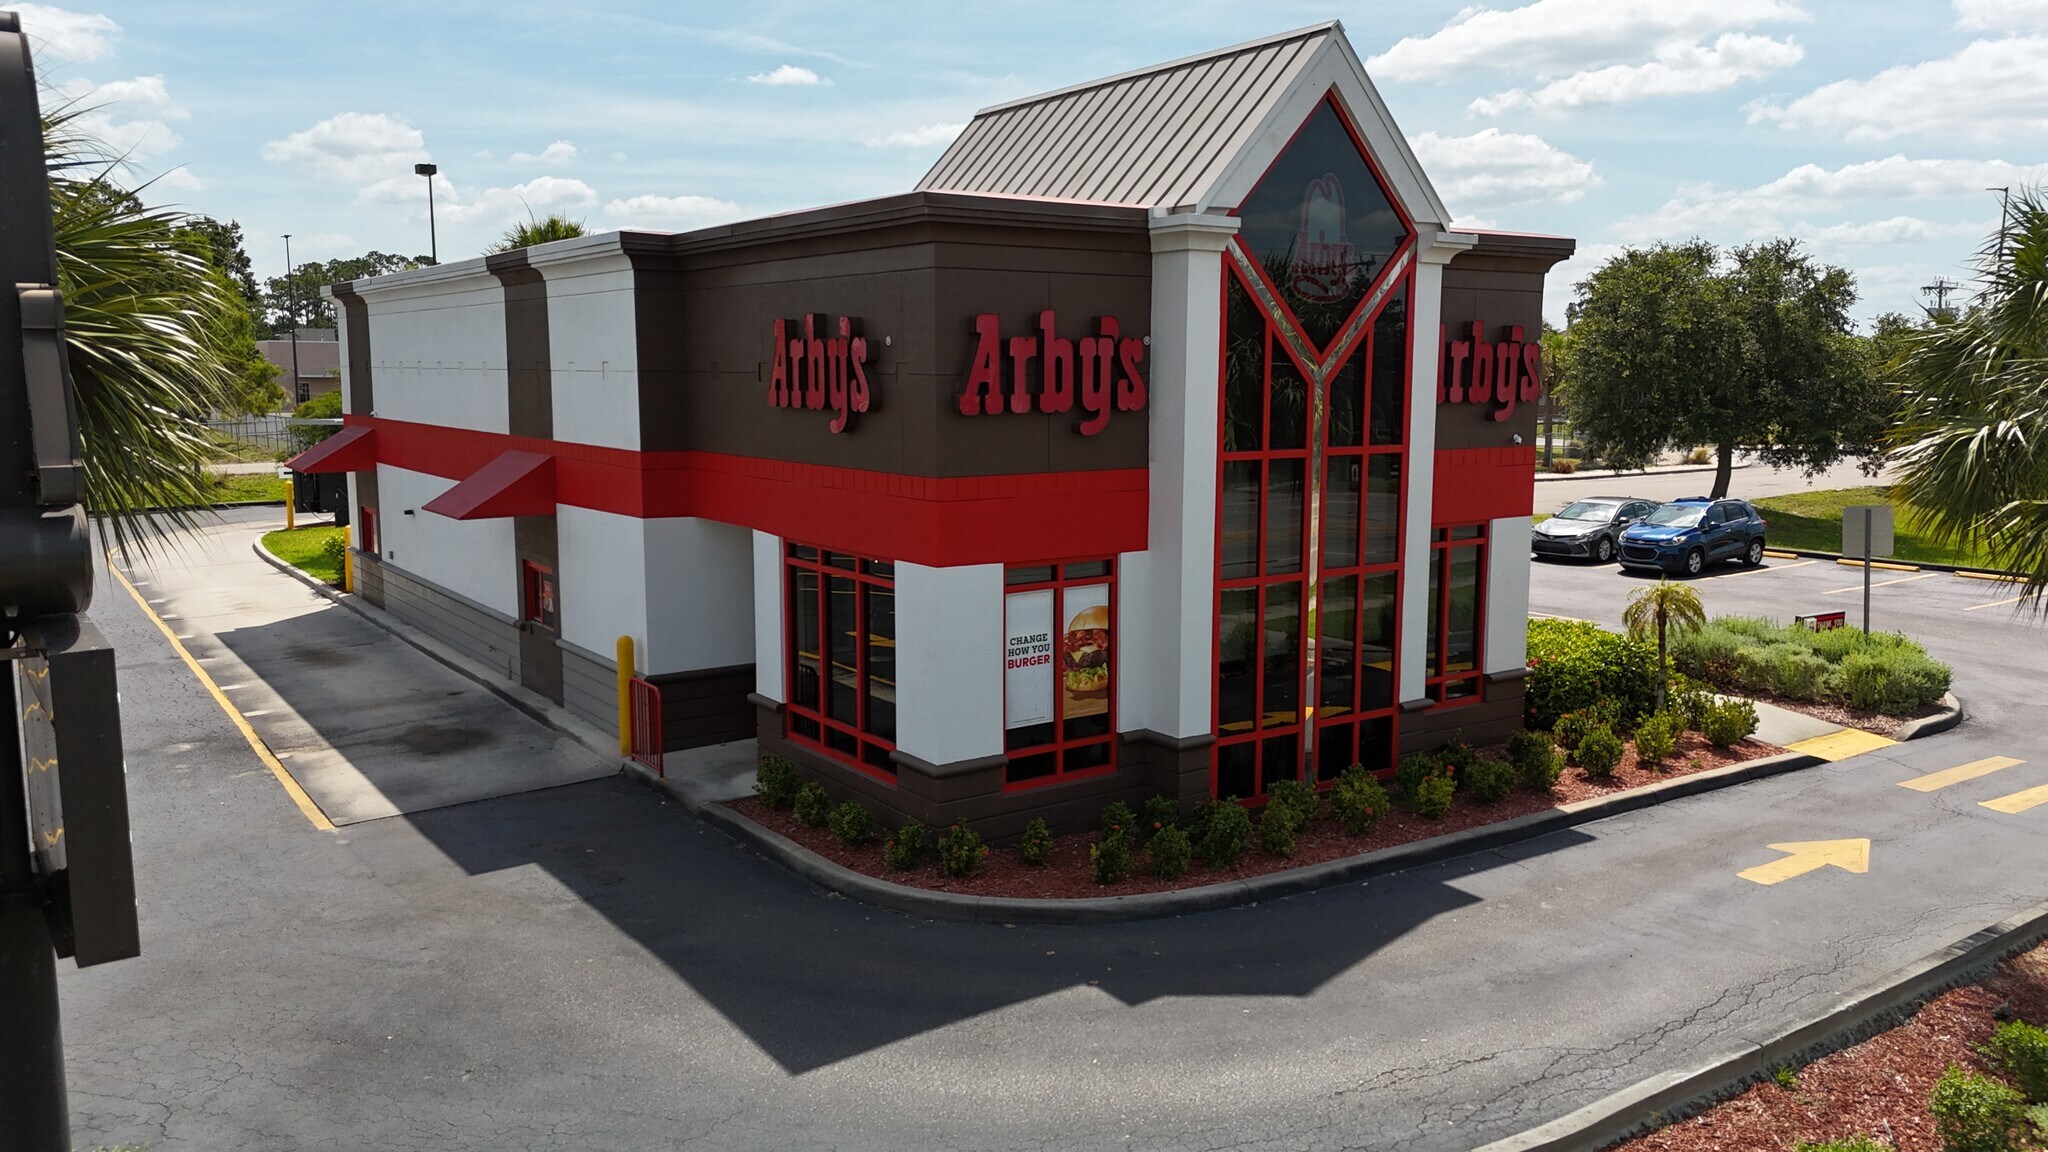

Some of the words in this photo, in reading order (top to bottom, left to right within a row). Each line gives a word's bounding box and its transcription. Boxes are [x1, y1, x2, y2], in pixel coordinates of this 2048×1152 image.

[767, 312, 870, 433] Arby's
[959, 310, 1147, 436] Arby's
[1009, 633, 1048, 646] CHANGE
[1007, 646, 1029, 657] HOW
[1032, 643, 1050, 654] YOU
[1007, 654, 1051, 670] BURGER
